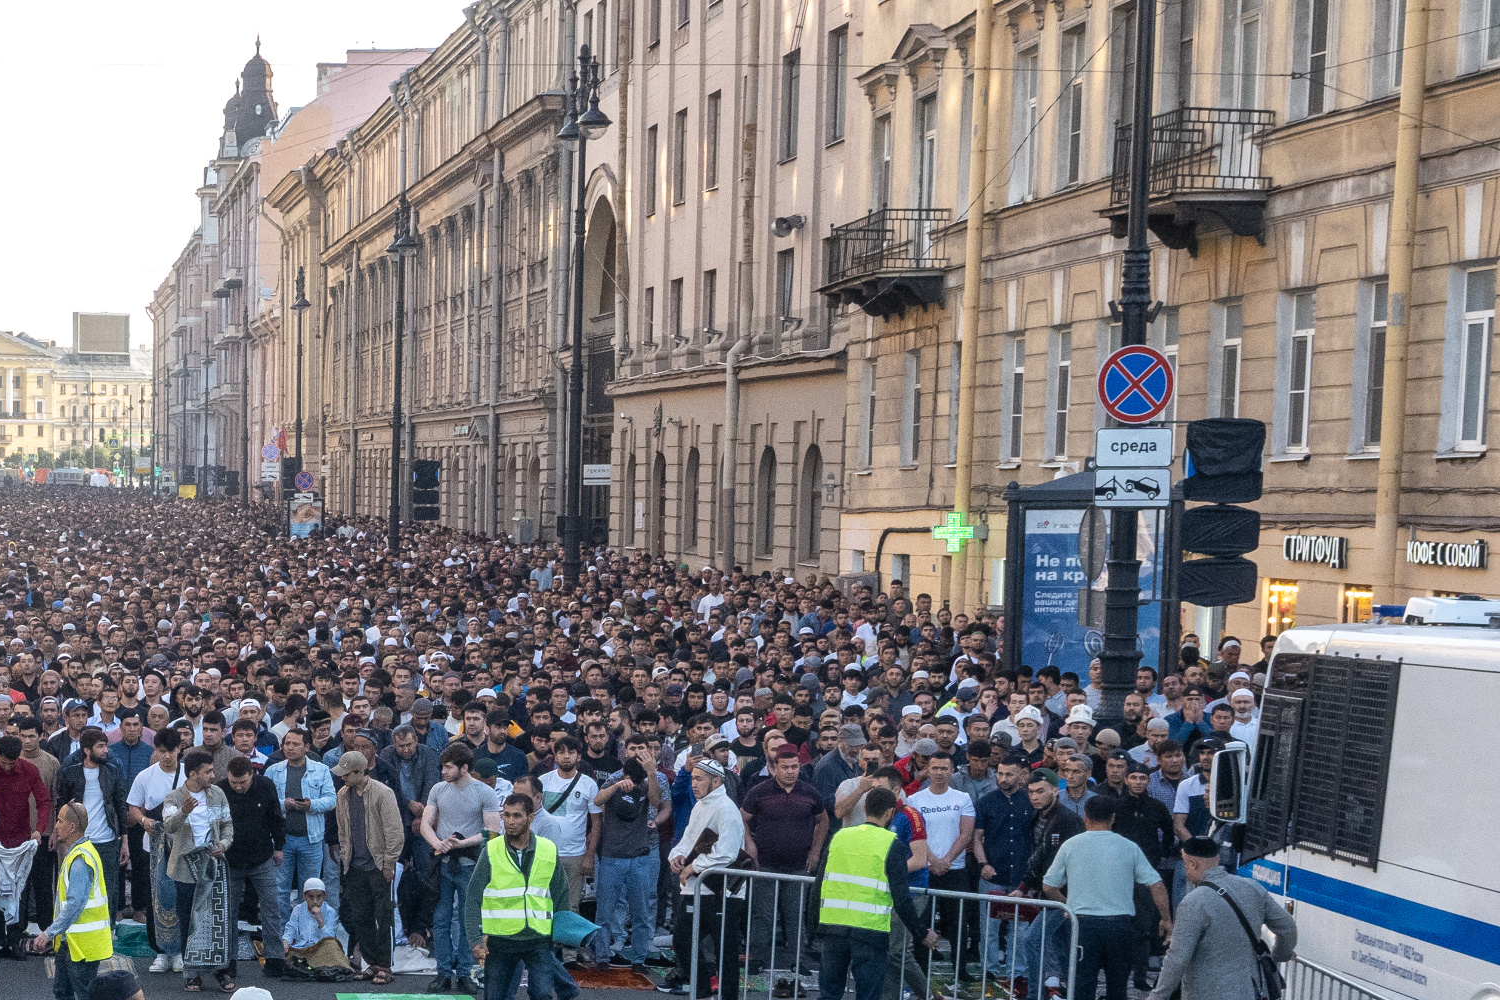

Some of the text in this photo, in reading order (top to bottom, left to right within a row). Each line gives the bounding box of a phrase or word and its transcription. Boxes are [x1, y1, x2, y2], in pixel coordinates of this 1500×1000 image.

[1111, 442, 1157, 455] среда
[1283, 535, 1339, 568] СТРИТФУД
[1407, 540, 1480, 567] КОФЕ С СОБОЙ
[1036, 554, 1060, 567] Не
[1035, 571, 1057, 581] на
[1034, 591, 1072, 600] Следите
[921, 805, 952, 815] Reebok
